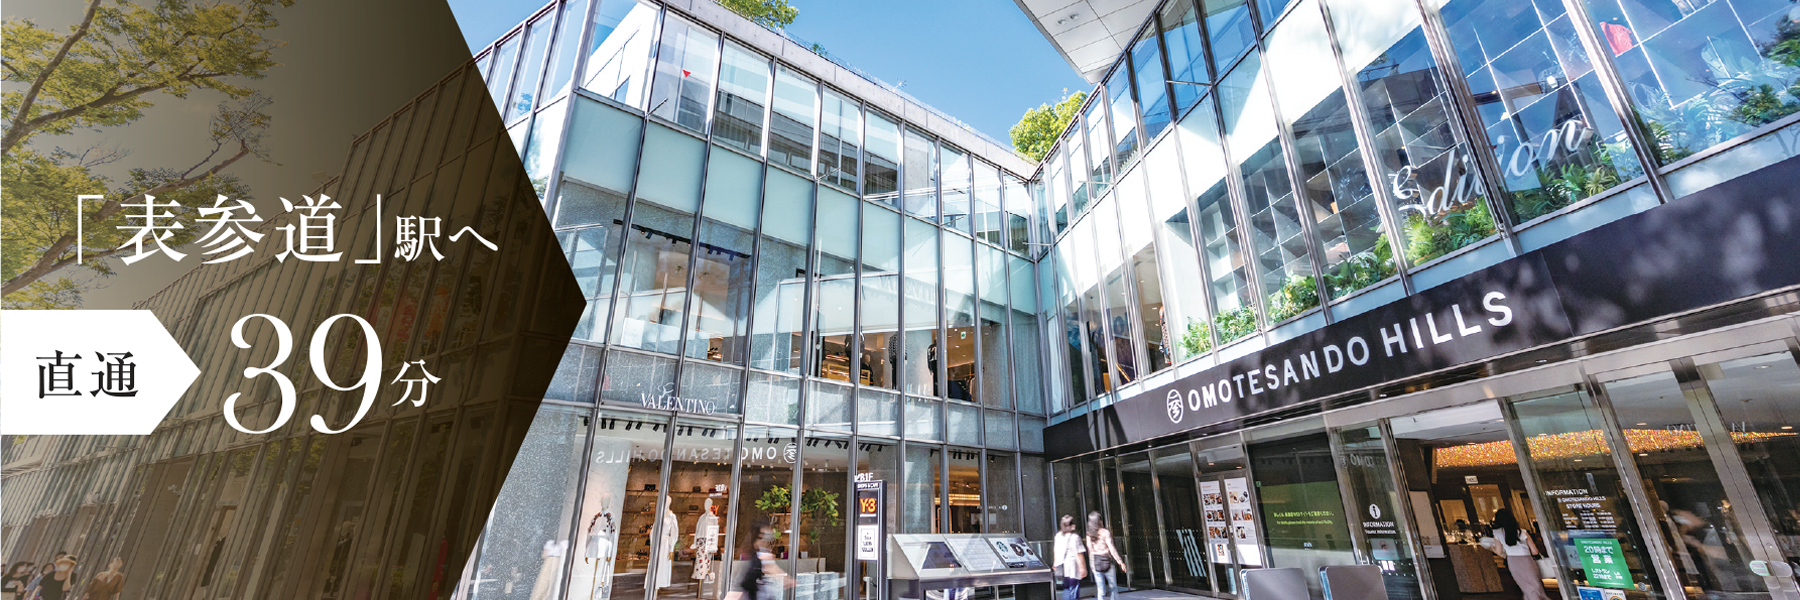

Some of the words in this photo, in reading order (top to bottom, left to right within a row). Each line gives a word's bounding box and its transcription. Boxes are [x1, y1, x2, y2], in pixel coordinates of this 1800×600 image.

[1187, 335, 1370, 412] OMOTESANDO
[1380, 291, 1513, 358] HILLS
[641, 391, 715, 416] VALENTINO
[859, 497, 877, 513] Y-3
